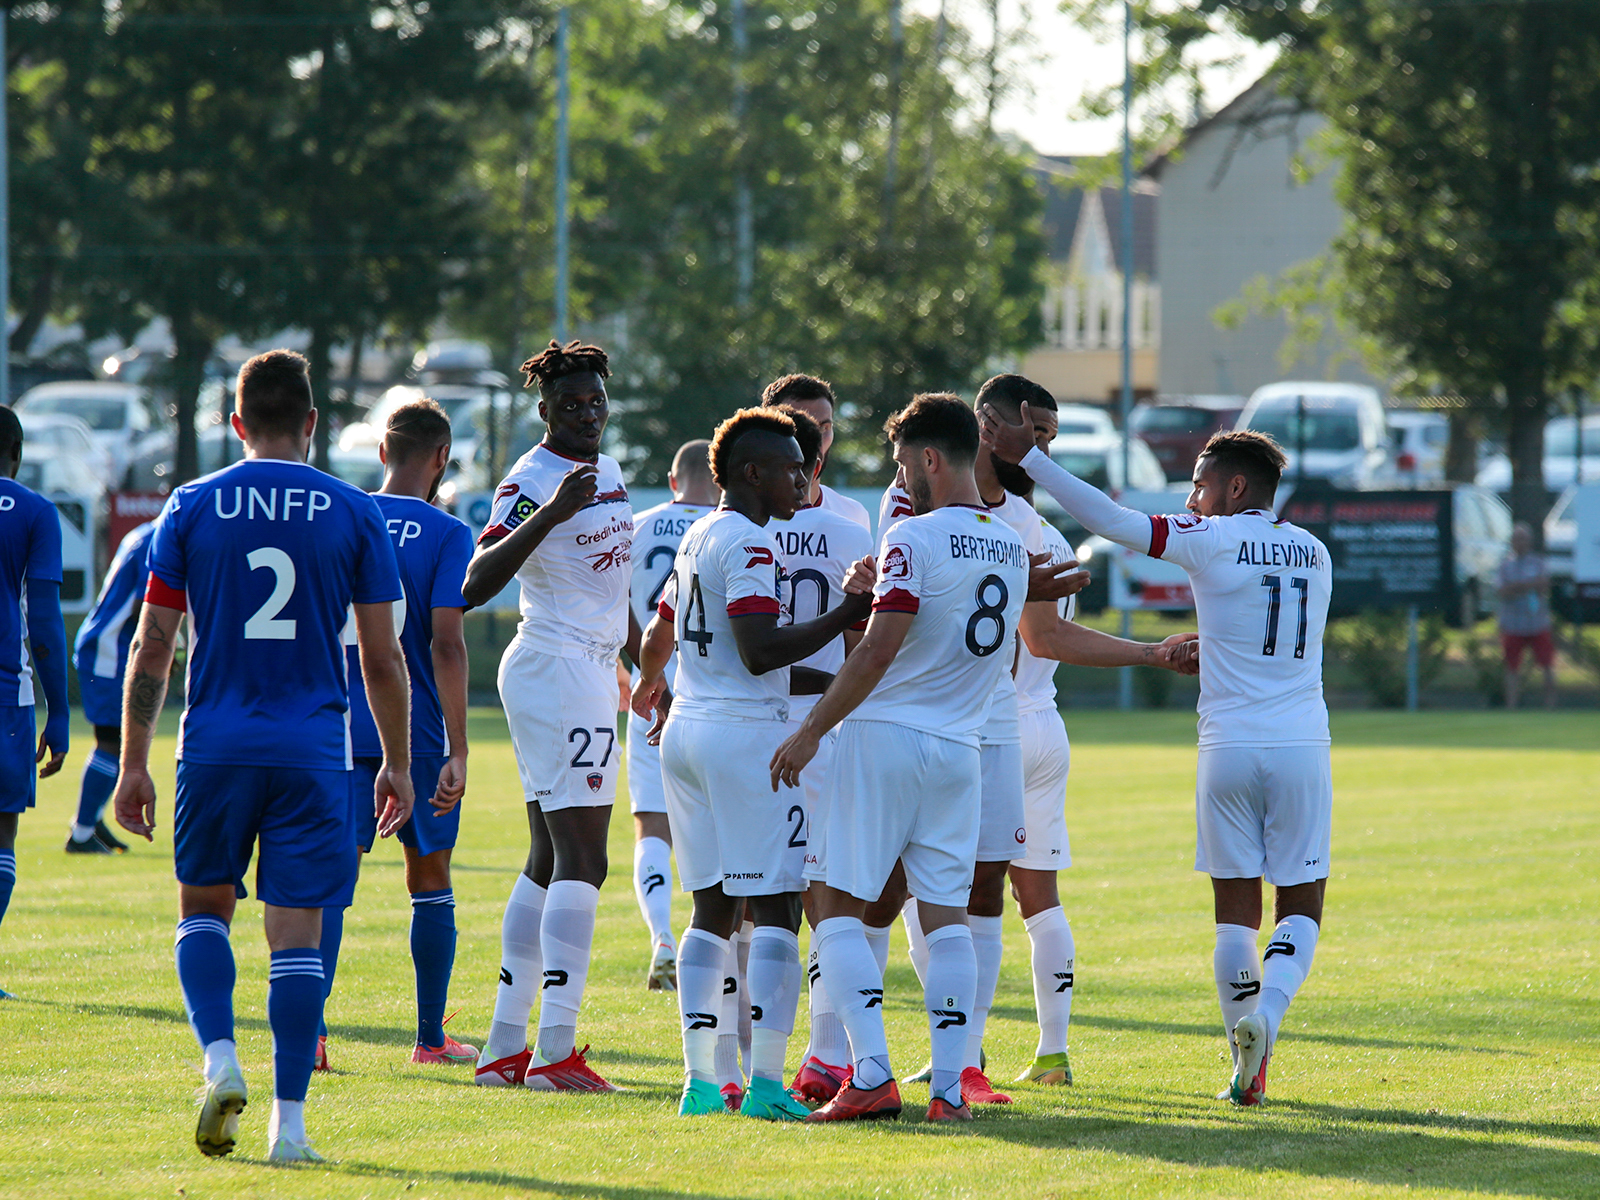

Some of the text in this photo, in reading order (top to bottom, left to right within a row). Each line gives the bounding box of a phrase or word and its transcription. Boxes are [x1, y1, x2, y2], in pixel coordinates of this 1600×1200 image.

[214, 486, 332, 521] UNFP
[575, 525, 612, 546] Crédit
[244, 547, 297, 640] 2
[674, 568, 714, 658] 4
[965, 573, 1009, 657] 8
[1261, 574, 1309, 660] 11
[568, 727, 615, 768] 27
[787, 804, 811, 849] 2
[732, 872, 764, 880] PATRICK
[1240, 970, 1249, 980] 11
[946, 997, 954, 1008] 8
